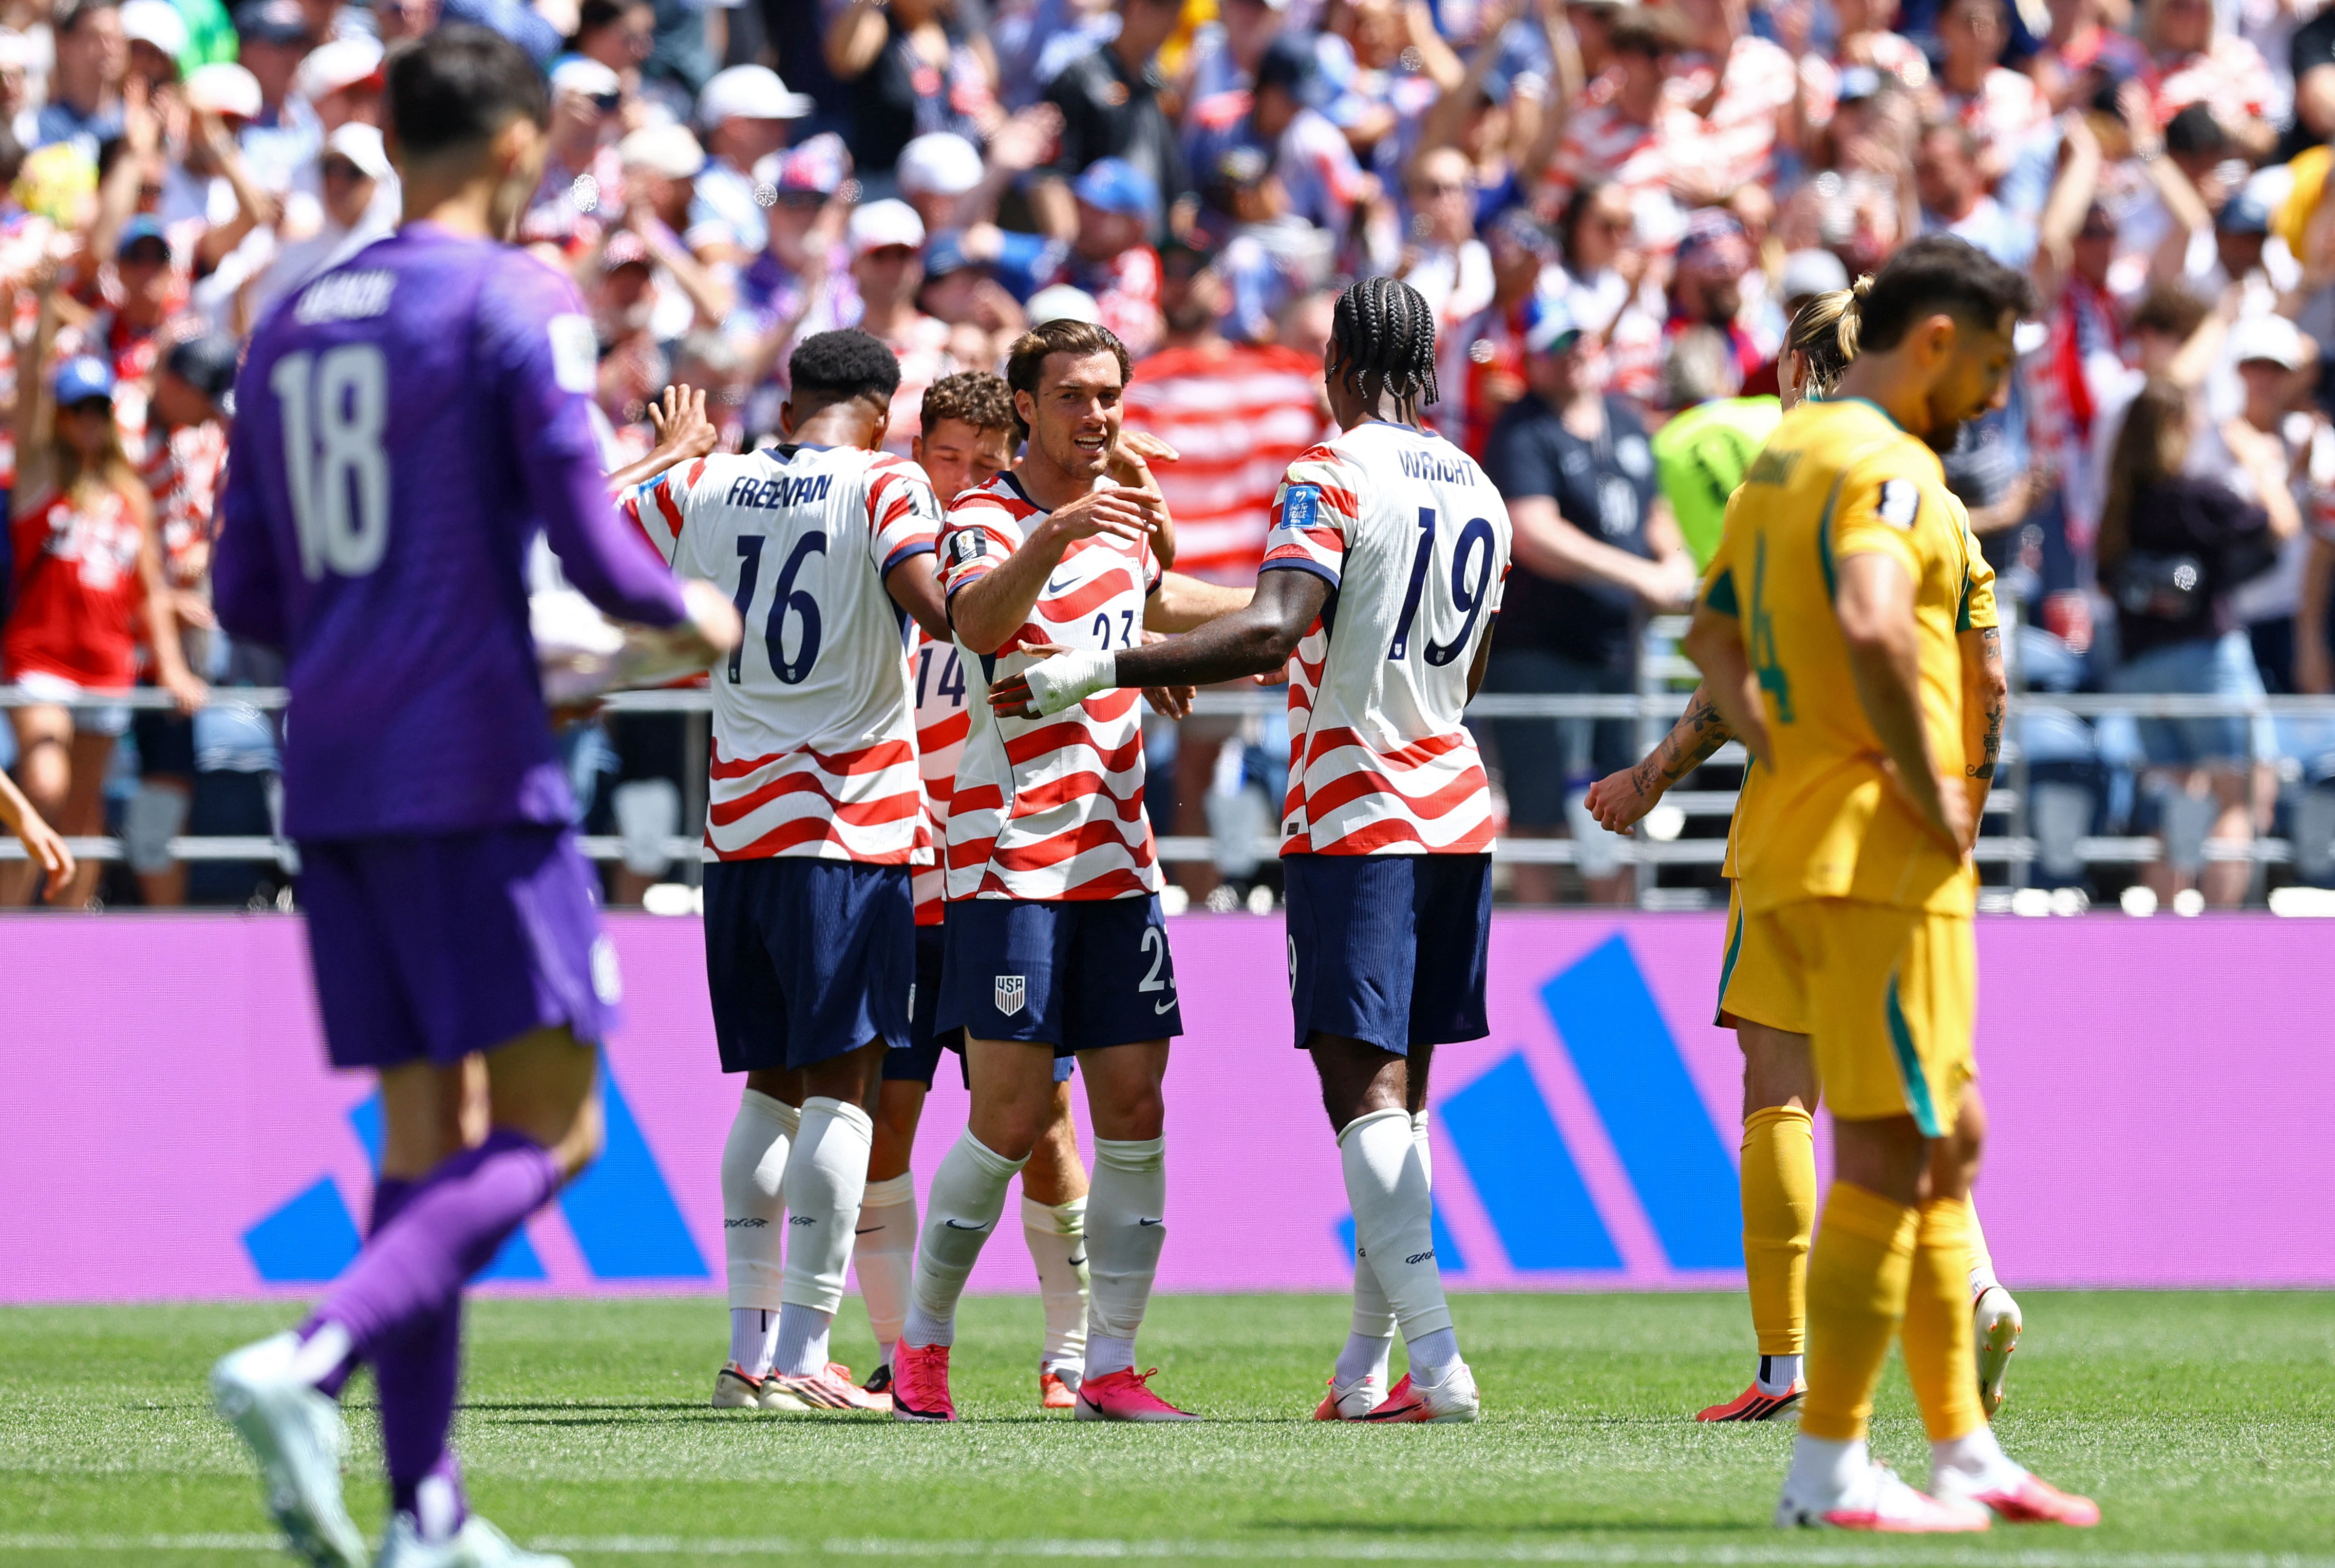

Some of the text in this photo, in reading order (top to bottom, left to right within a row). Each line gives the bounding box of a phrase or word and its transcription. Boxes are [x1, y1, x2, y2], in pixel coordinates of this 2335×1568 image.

[271, 343, 389, 582] 18
[1397, 449, 1475, 486] WRIGHT
[1289, 511, 1307, 519] PEACE
[728, 531, 827, 685] 16
[1387, 506, 1495, 667] 19
[1093, 610, 1134, 650] 23
[917, 646, 966, 709] 14
[997, 978, 1023, 993] USA
[1139, 926, 1175, 992] 2
